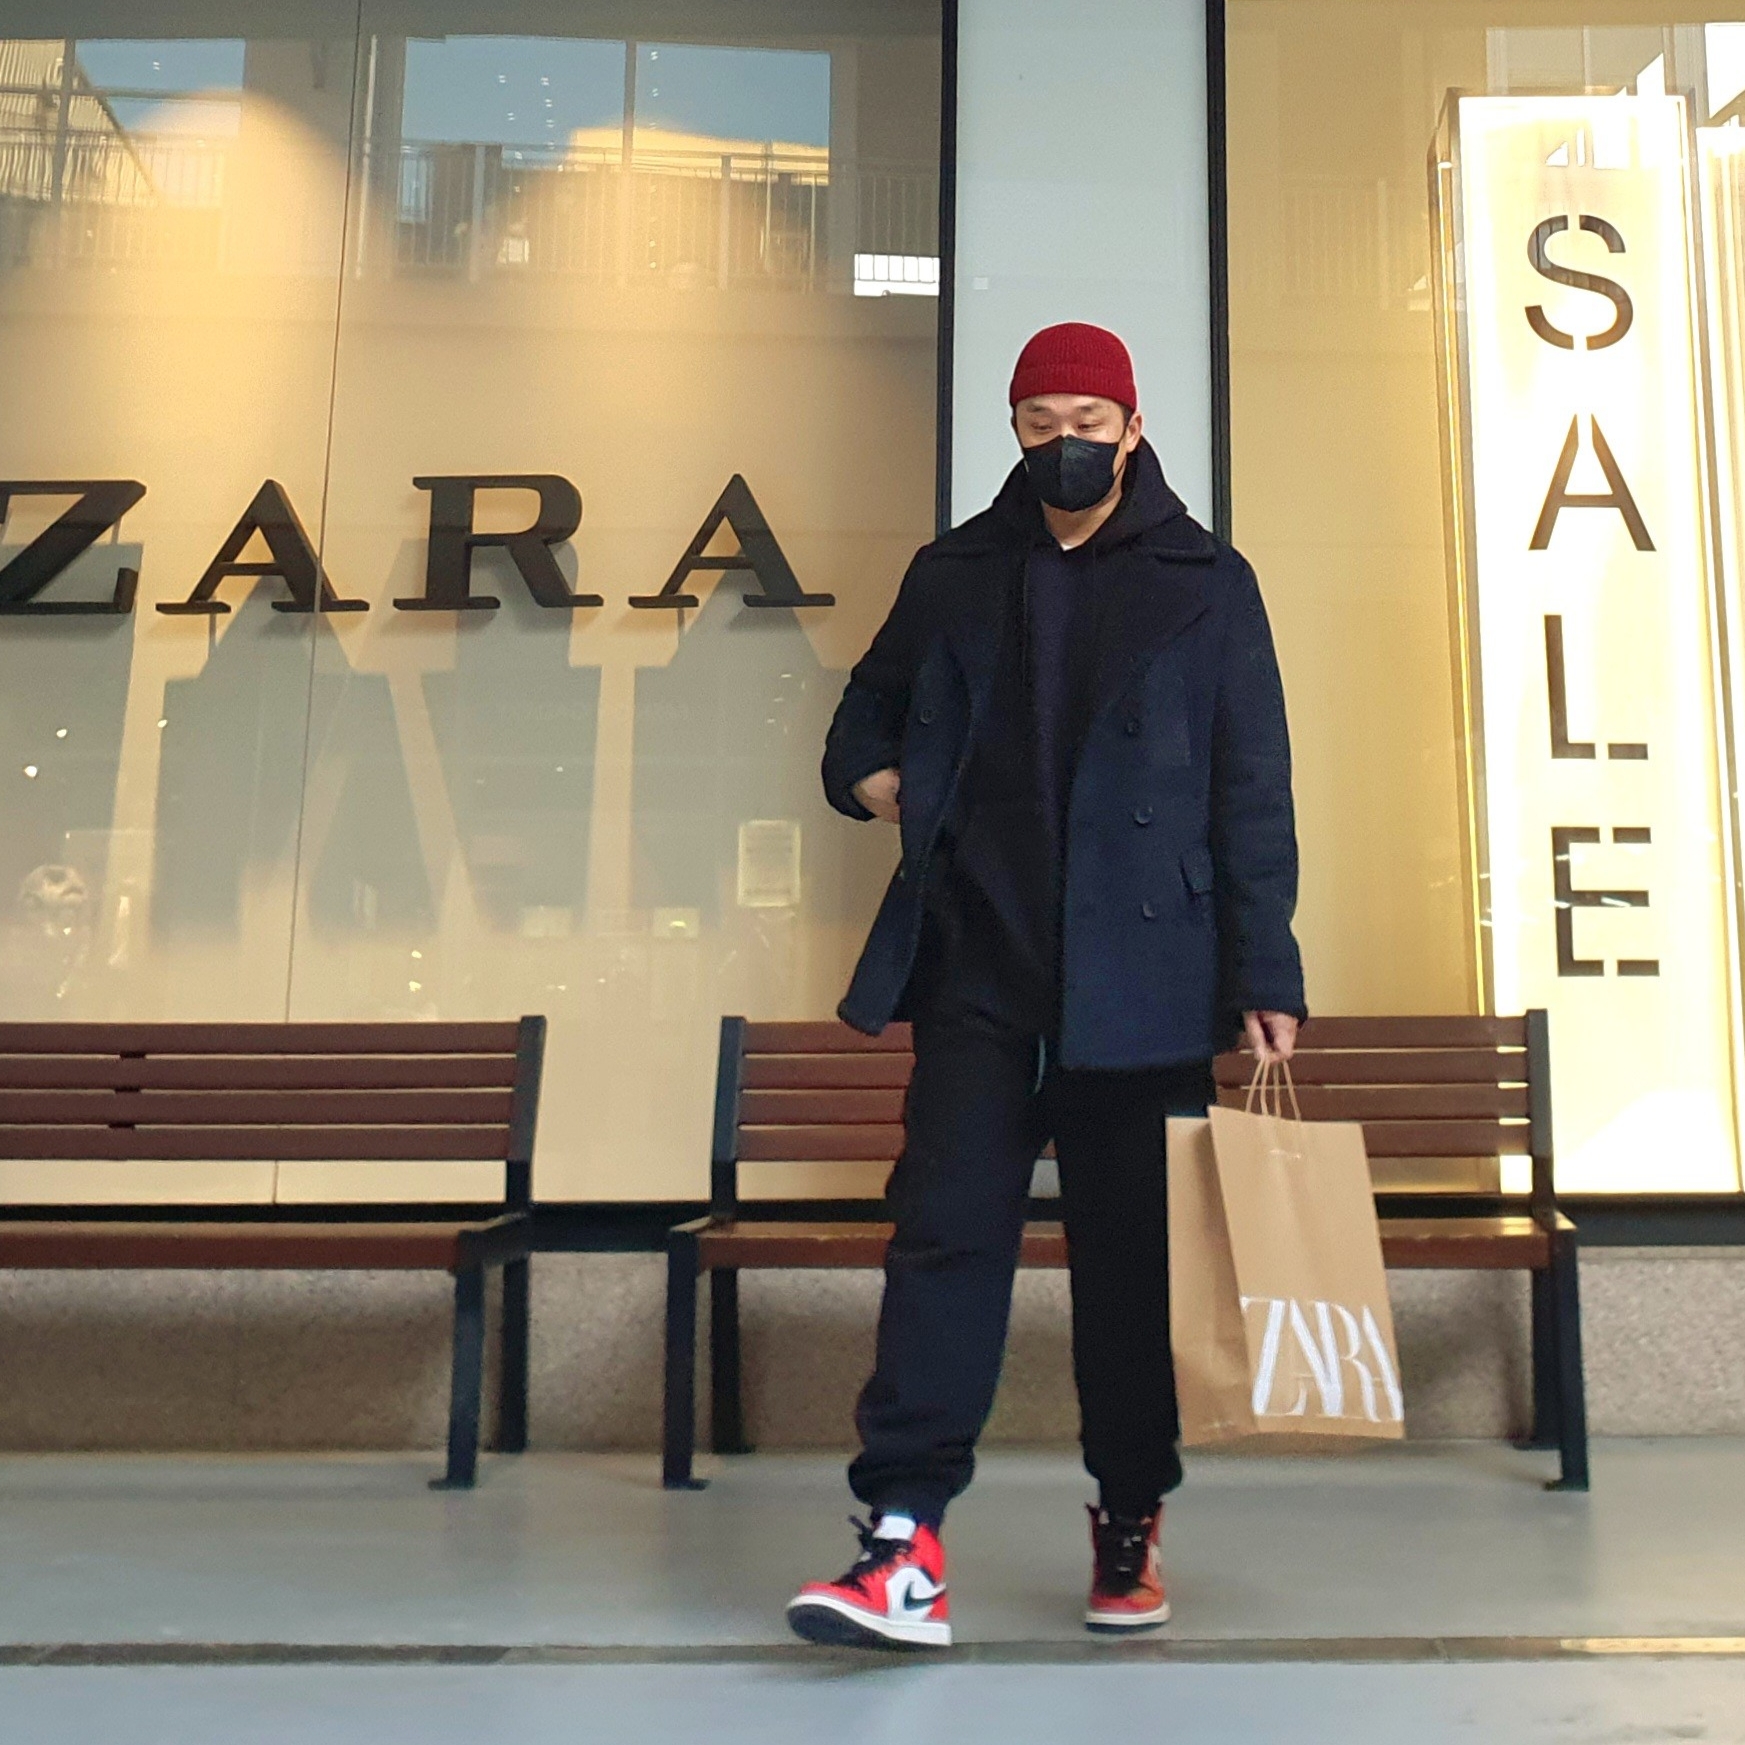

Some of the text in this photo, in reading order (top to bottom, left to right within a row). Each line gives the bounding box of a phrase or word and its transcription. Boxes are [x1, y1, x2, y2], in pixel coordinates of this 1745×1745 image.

[0, 473, 835, 614] ZARA
[1525, 214, 1660, 977] SALE
[1240, 1296, 1405, 1423] ZARA
